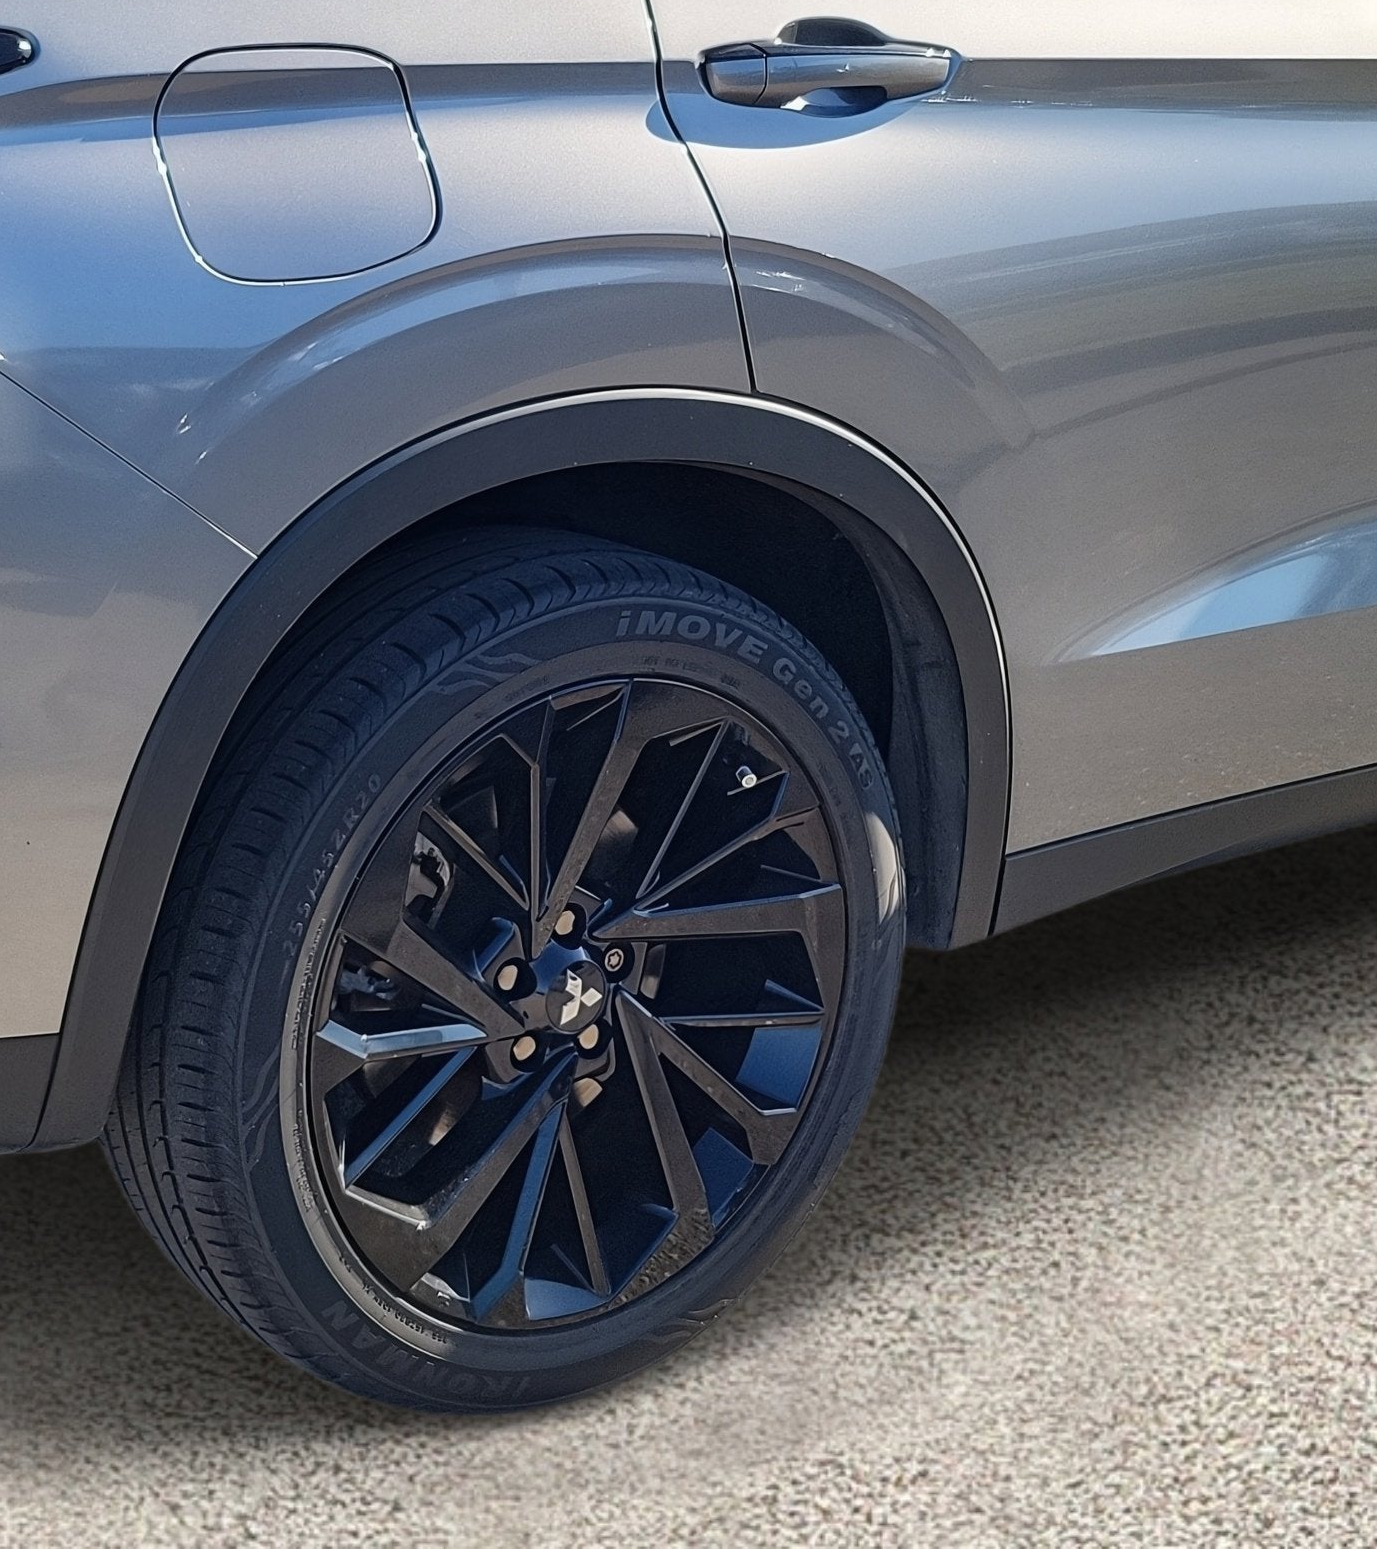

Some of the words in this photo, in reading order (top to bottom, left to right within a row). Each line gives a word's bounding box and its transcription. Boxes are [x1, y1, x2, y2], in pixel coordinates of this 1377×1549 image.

[616, 611, 769, 664] iMOVE
[772, 657, 829, 719] Gen
[828, 720, 850, 744] 2
